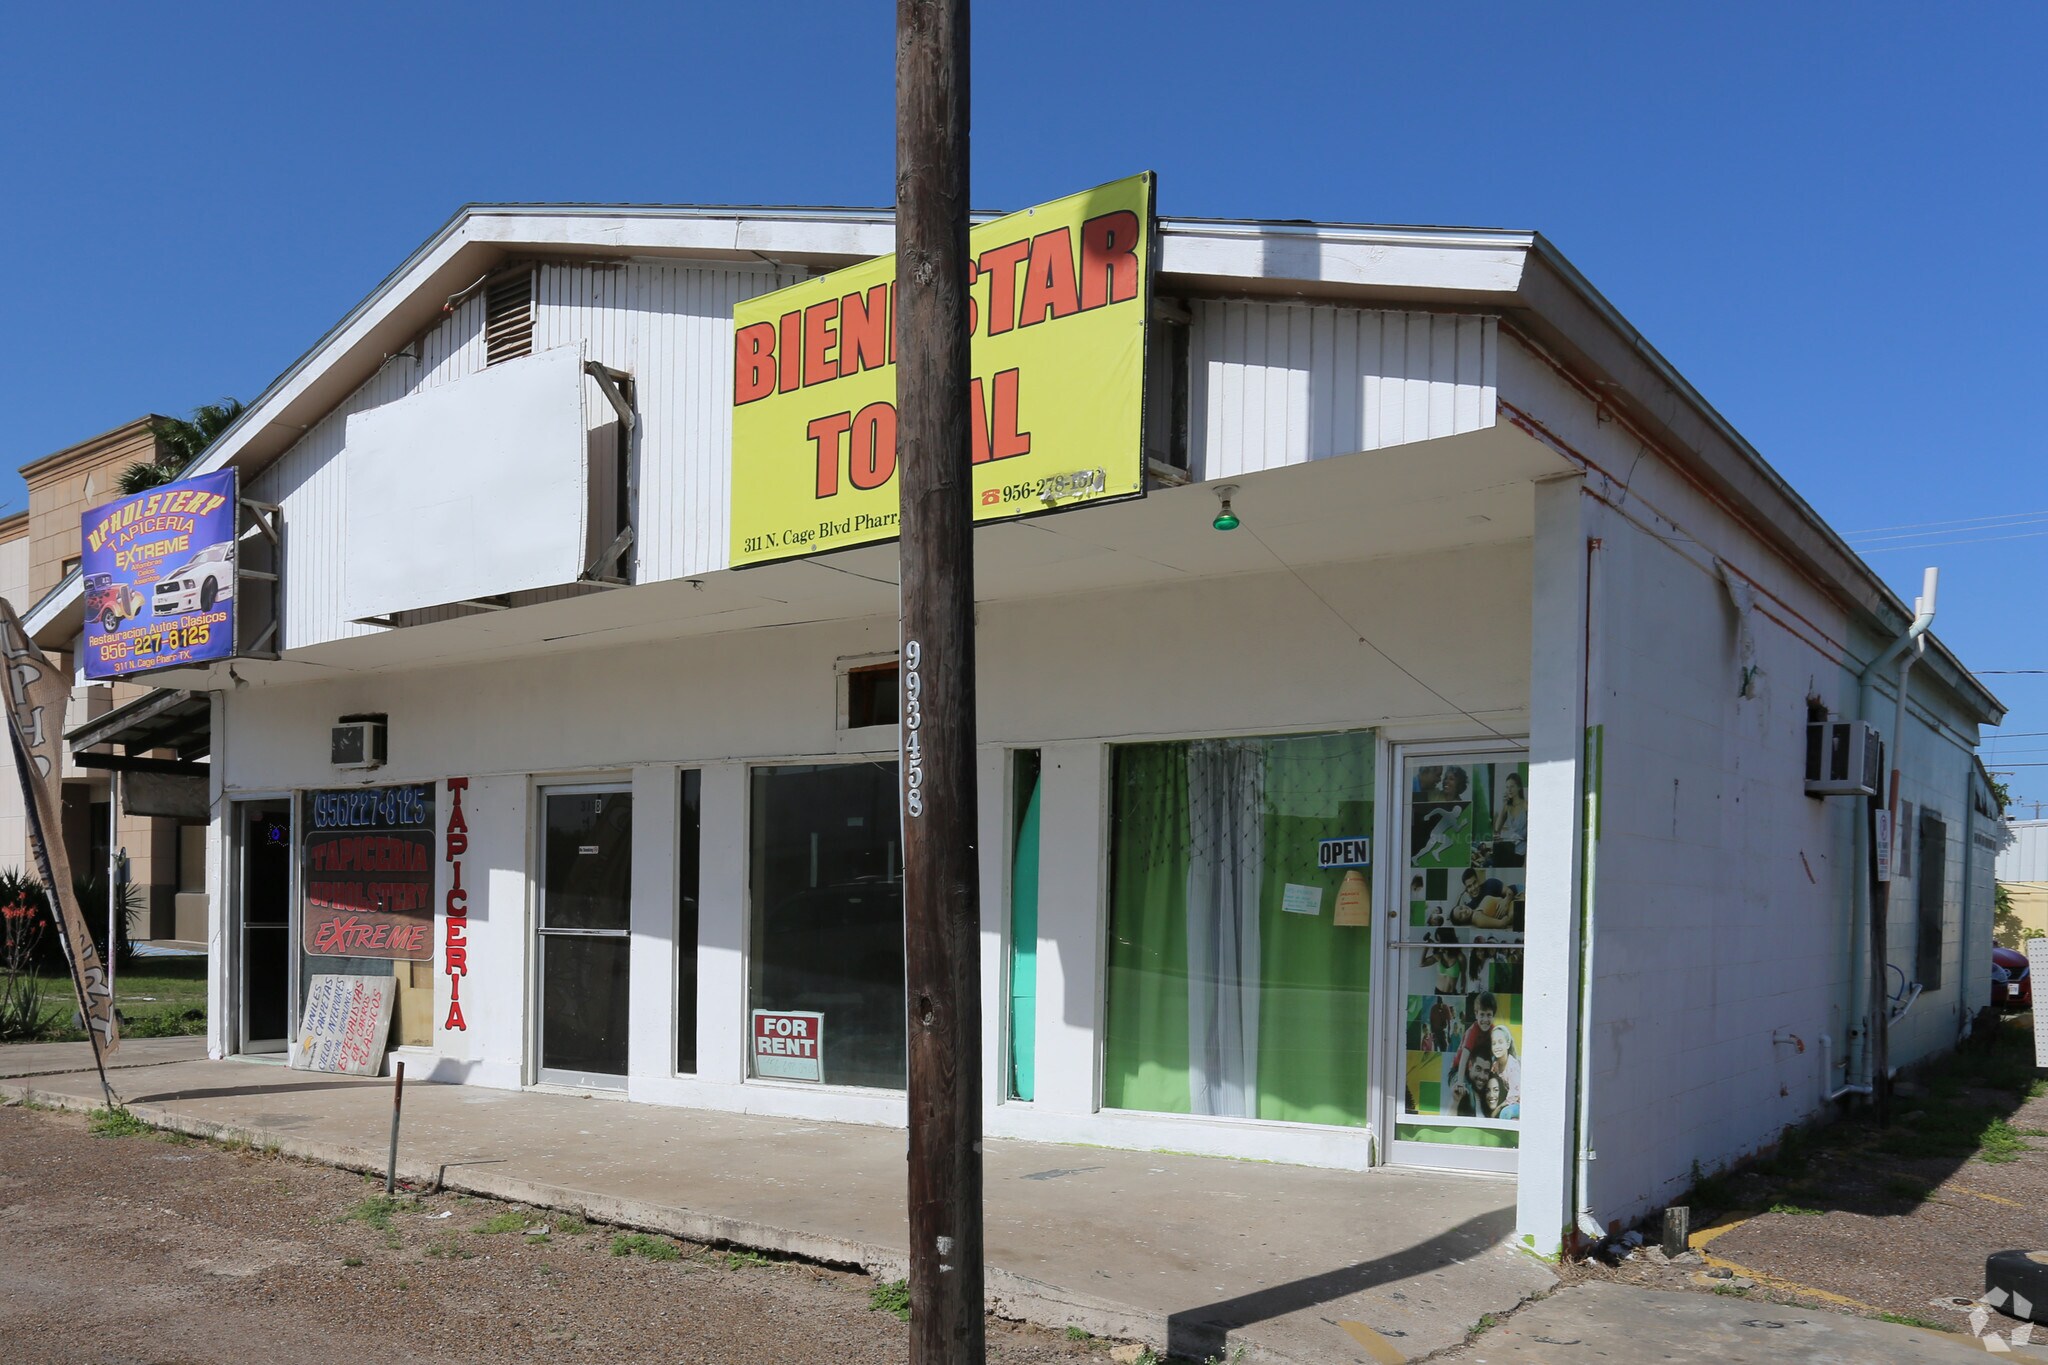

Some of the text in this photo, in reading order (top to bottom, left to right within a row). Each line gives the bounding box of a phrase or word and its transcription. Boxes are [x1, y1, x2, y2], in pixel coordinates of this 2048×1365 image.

[734, 209, 1140, 407] BIENTAR
[807, 367, 1031, 499] TOL
[87, 490, 226, 553] UPHOLSTERY
[108, 516, 194, 551] TAPICERIA
[744, 536, 762, 553] 311
[765, 532, 779, 549] N.
[783, 529, 815, 545] Cage
[819, 518, 850, 539] Blvd
[116, 534, 189, 572] EXTREME
[89, 627, 147, 647] Restauracion
[149, 620, 178, 634] Autos
[180, 611, 227, 628] Clasicos
[100, 624, 210, 661] 956-227-8125
[114, 659, 129, 672] 311
[129, 658, 137, 670] N.
[138, 657, 155, 669] Cage
[906, 640, 923, 818] 993458
[311, 836, 428, 872] TAPICERIA
[1320, 840, 1367, 865] OPEN
[310, 881, 429, 913] UPHOLSTERY
[445, 777, 469, 1032] TAPICERIA
[314, 916, 427, 953] EXTREME
[306, 984, 322, 1032] VINILES
[315, 976, 333, 1037] CARPETAS
[318, 976, 345, 1071] CIELOS INTERIORES
[338, 988, 353, 1035] HEADLINER
[337, 980, 364, 1072] ESPECIALISTAS
[350, 993, 371, 1062] EN CARROS
[359, 988, 382, 1066] CLASSICOS
[763, 1018, 808, 1037] FOR
[757, 1036, 815, 1056] RENT
